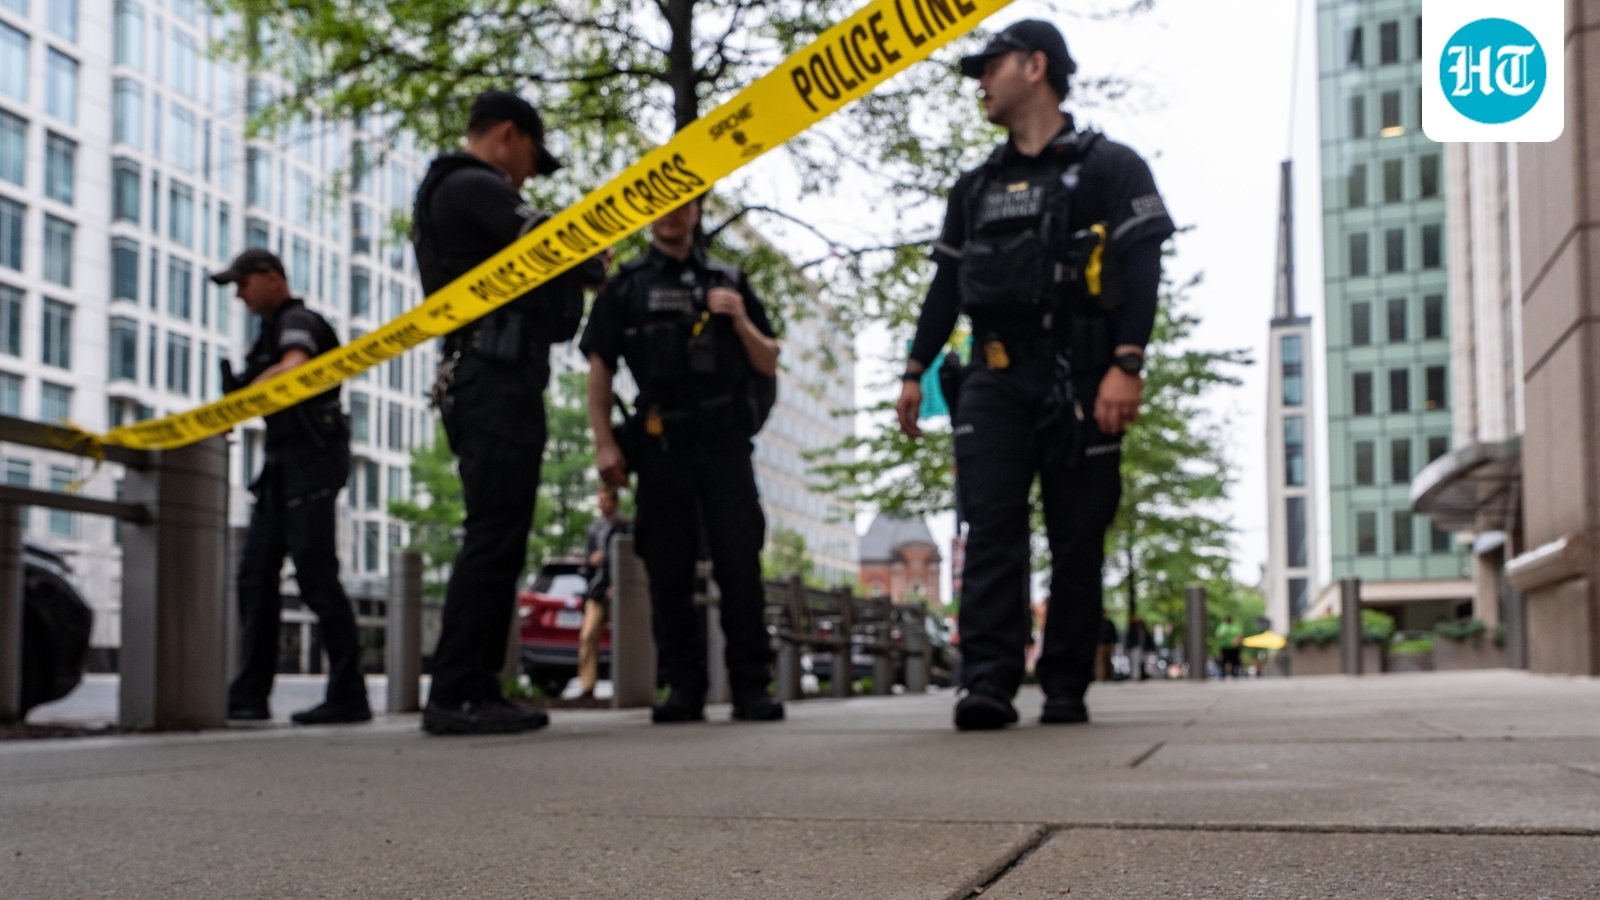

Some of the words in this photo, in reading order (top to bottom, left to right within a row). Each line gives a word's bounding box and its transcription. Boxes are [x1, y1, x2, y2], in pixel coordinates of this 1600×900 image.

[790, 10, 903, 113] POLICE
[556, 221, 599, 254] DO
[582, 196, 637, 238] NOT
[622, 153, 706, 216] CROSS
